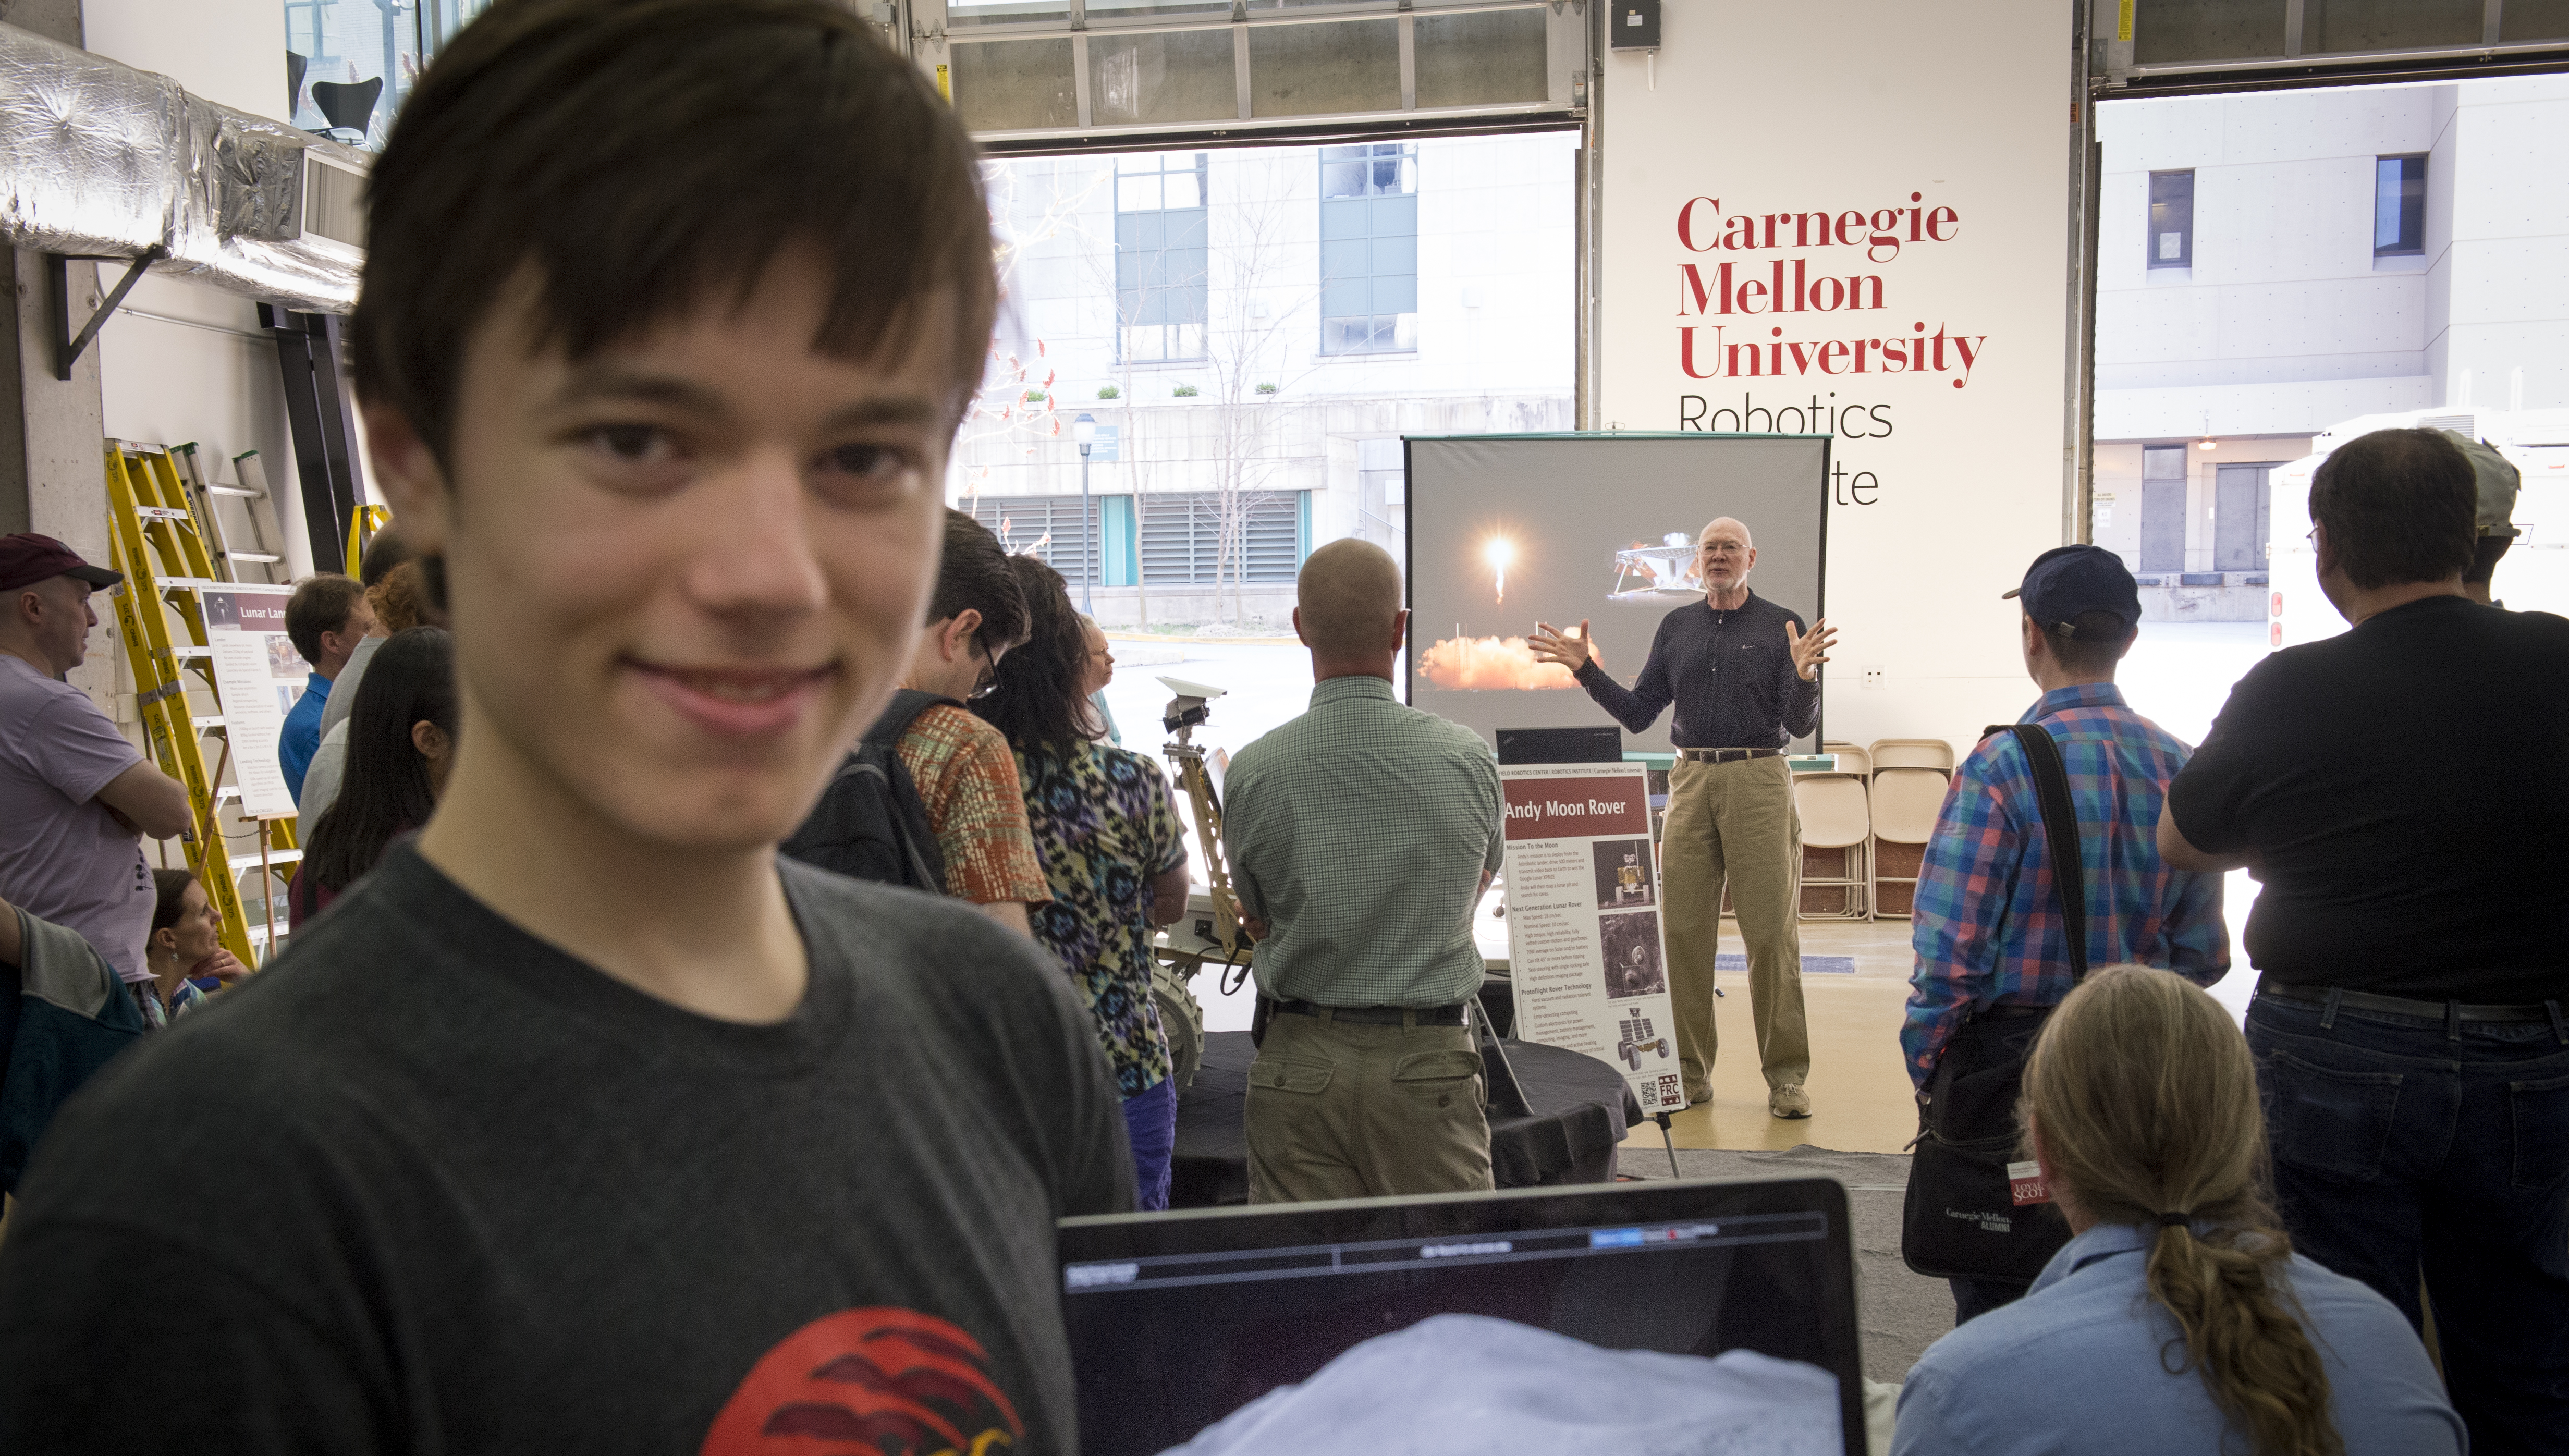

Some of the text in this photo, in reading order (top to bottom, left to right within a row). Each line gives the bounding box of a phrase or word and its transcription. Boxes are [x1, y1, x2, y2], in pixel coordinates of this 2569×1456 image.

[1677, 191, 1959, 263] Carnegie
[1676, 258, 1888, 316] Mellon
[1676, 321, 1988, 389] University
[1681, 391, 1893, 438] Robotics
[140, 579, 149, 592] 375
[123, 603, 131, 615] 375
[240, 607, 266, 618] Lunar
[130, 629, 139, 647] RHINO
[1505, 799, 1626, 822] Andy Moon Rover
[1660, 1083, 1679, 1096] FRC
[2014, 1188, 2043, 1202] SCOT
[1946, 1207, 1981, 1221] Carnegie
[1981, 1221, 2010, 1232] ALUMNI
